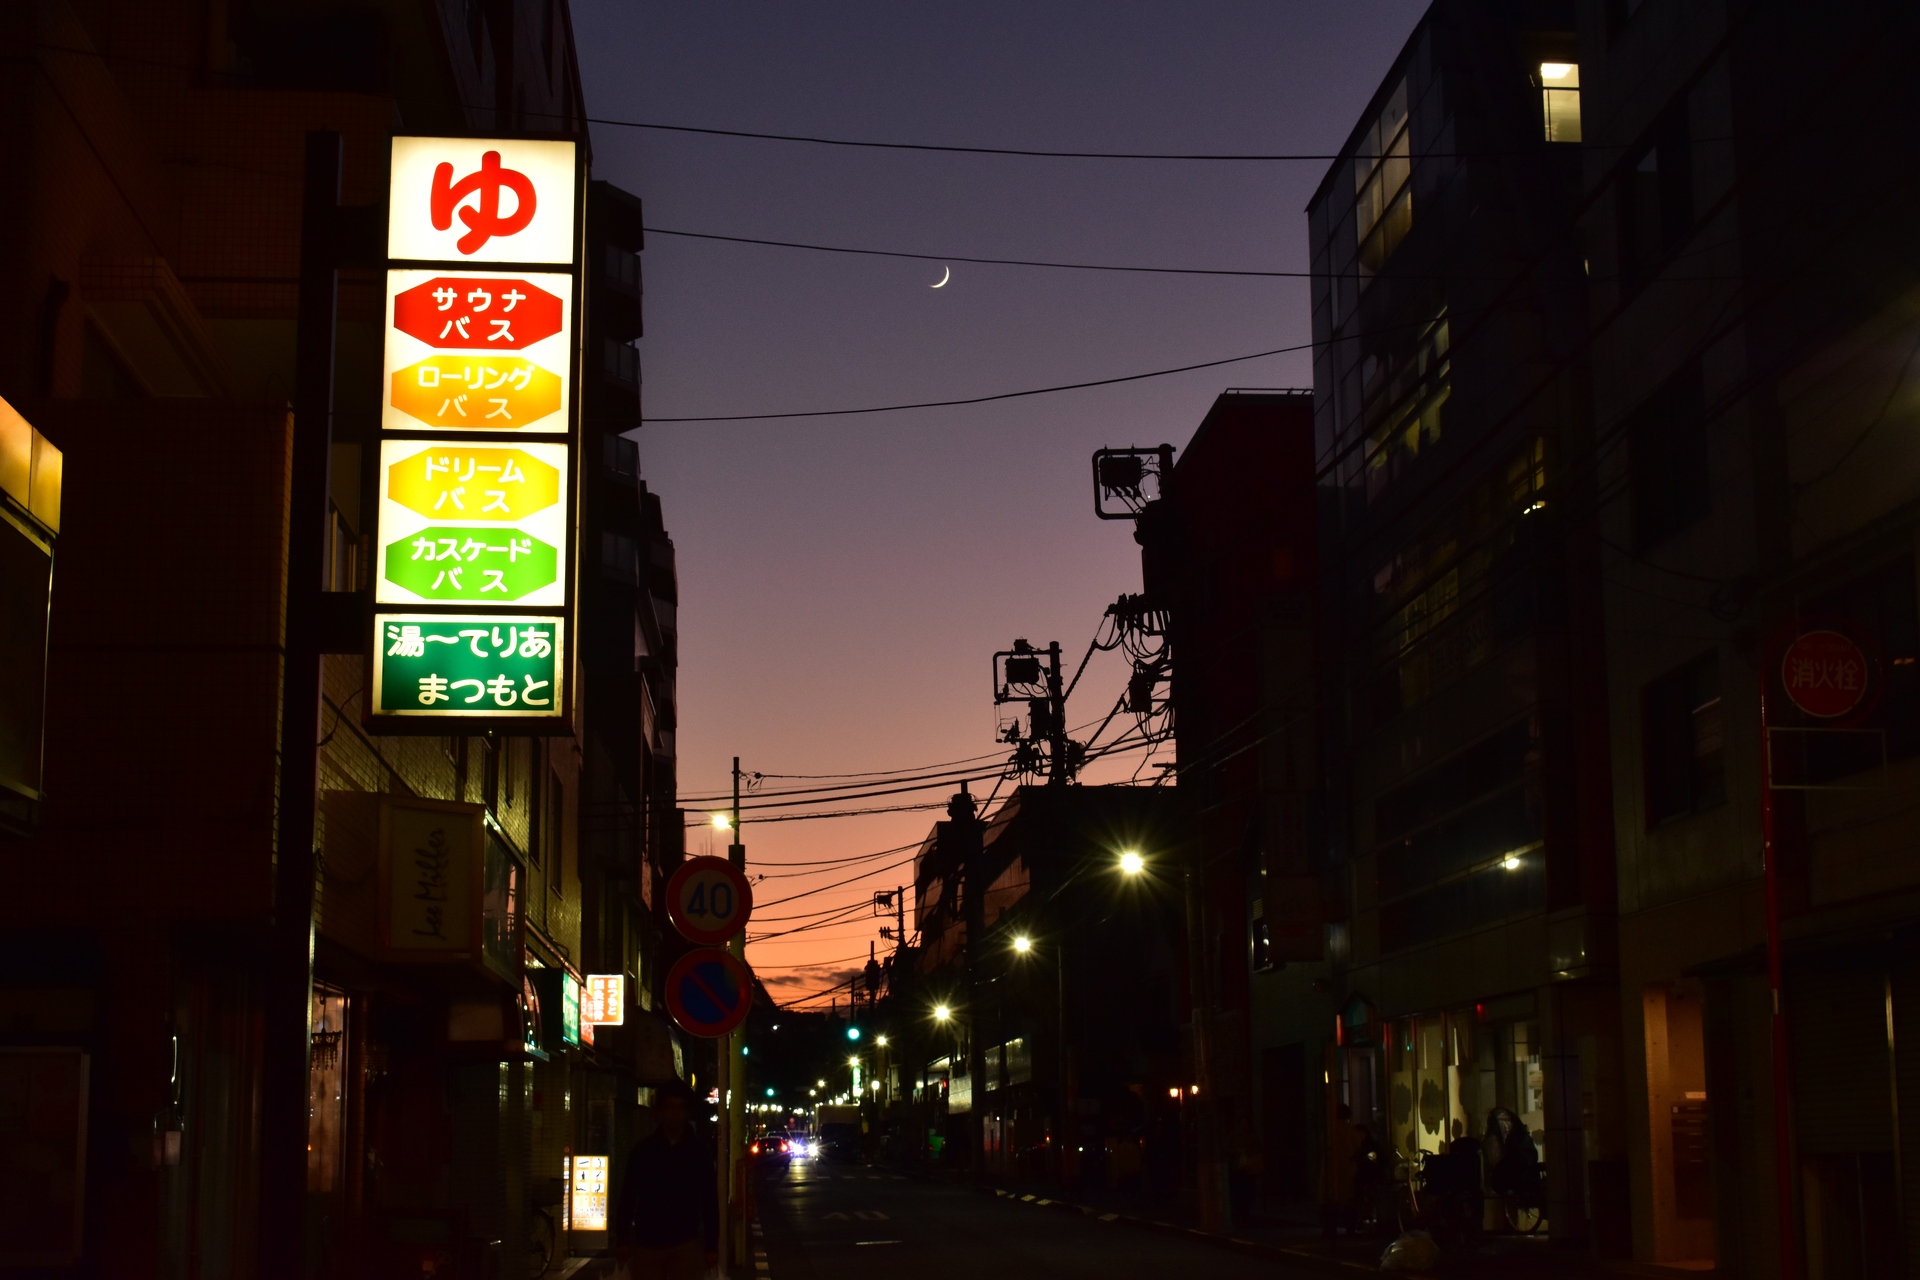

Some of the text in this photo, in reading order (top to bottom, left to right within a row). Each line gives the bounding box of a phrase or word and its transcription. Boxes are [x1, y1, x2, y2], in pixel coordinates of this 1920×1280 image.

[430, 150, 537, 255] ゆ
[431, 286, 527, 313] サウナ
[439, 315, 515, 342] バス
[417, 364, 536, 391] ローリング
[436, 393, 513, 420] バス
[425, 455, 526, 484] ドリーム
[433, 486, 511, 513] バス
[410, 536, 532, 563] カスケード
[431, 566, 508, 593] バス
[1790, 656, 1860, 690] 消火栓
[417, 673, 551, 707] まつもと
[686, 881, 733, 920] 40
[411, 904, 447, 941] Lee
